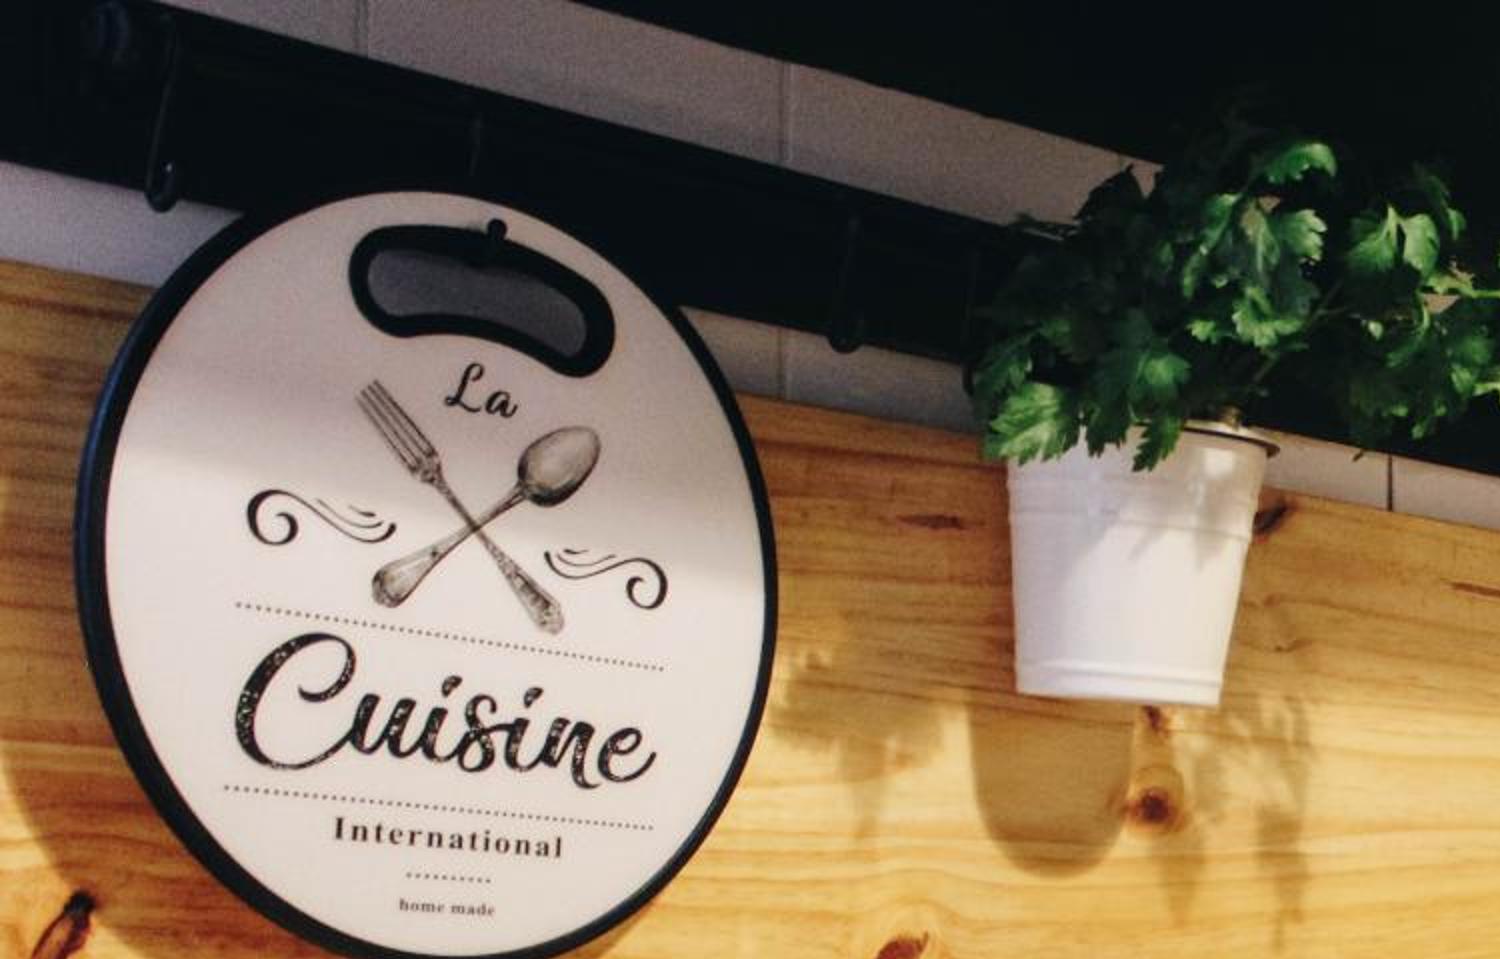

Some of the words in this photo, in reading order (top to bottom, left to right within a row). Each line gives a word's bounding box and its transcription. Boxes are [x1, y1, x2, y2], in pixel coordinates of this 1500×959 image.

[444, 363, 518, 418] La
[234, 632, 657, 790] Cuisine
[335, 817, 562, 858] International
[399, 898, 445, 913] home
[450, 902, 495, 916] made
